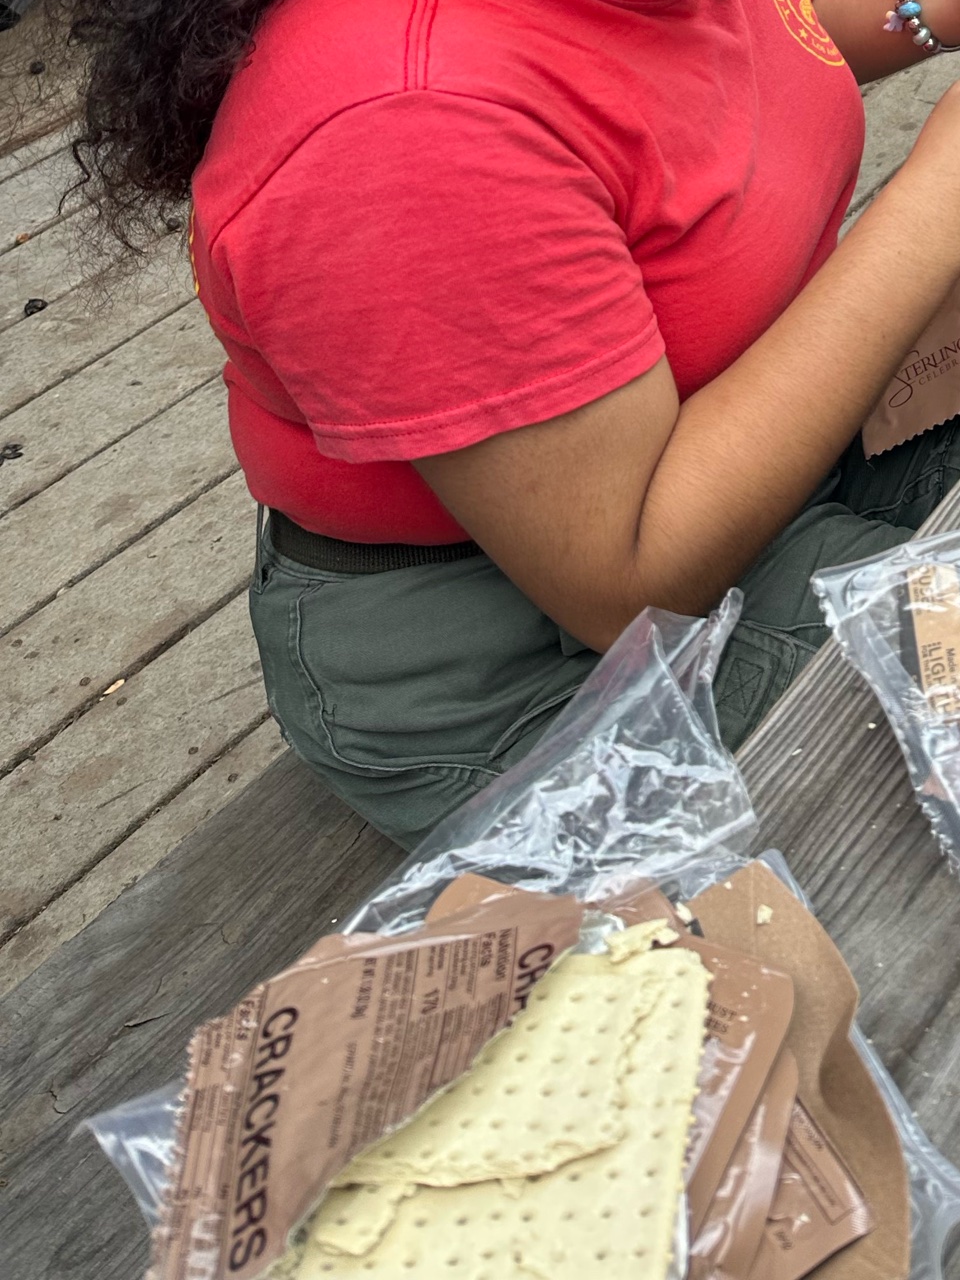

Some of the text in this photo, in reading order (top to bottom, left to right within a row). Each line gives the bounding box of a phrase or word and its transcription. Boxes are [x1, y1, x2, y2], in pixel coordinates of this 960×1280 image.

[946, 647, 956, 673] Made
[479, 931, 497, 969] Facts
[495, 928, 512, 982] Nutrition
[227, 1005, 301, 1274] CRACKERS
